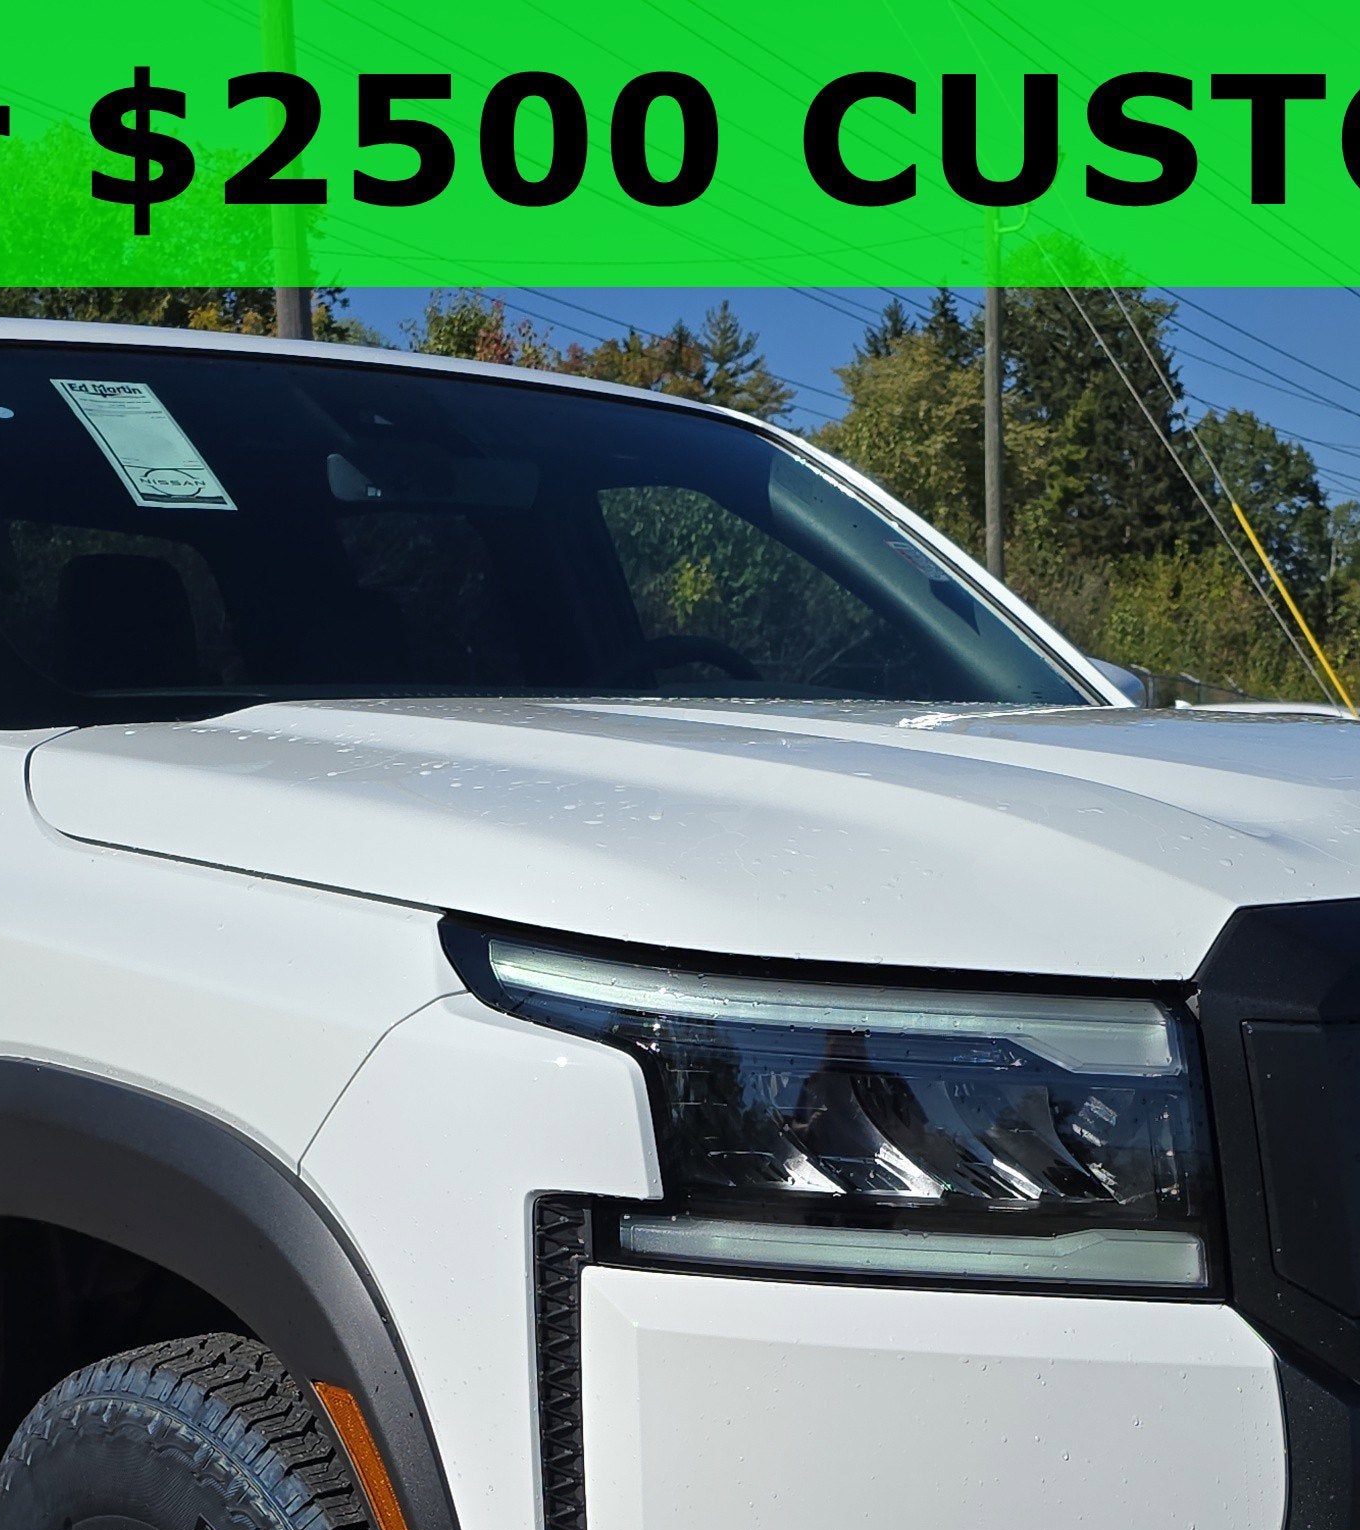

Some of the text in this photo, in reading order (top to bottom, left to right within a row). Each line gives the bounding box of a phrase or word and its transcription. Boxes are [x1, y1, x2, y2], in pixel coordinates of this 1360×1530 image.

[67, 382, 143, 395] Ed Martin
[139, 476, 206, 487] NISSAN
